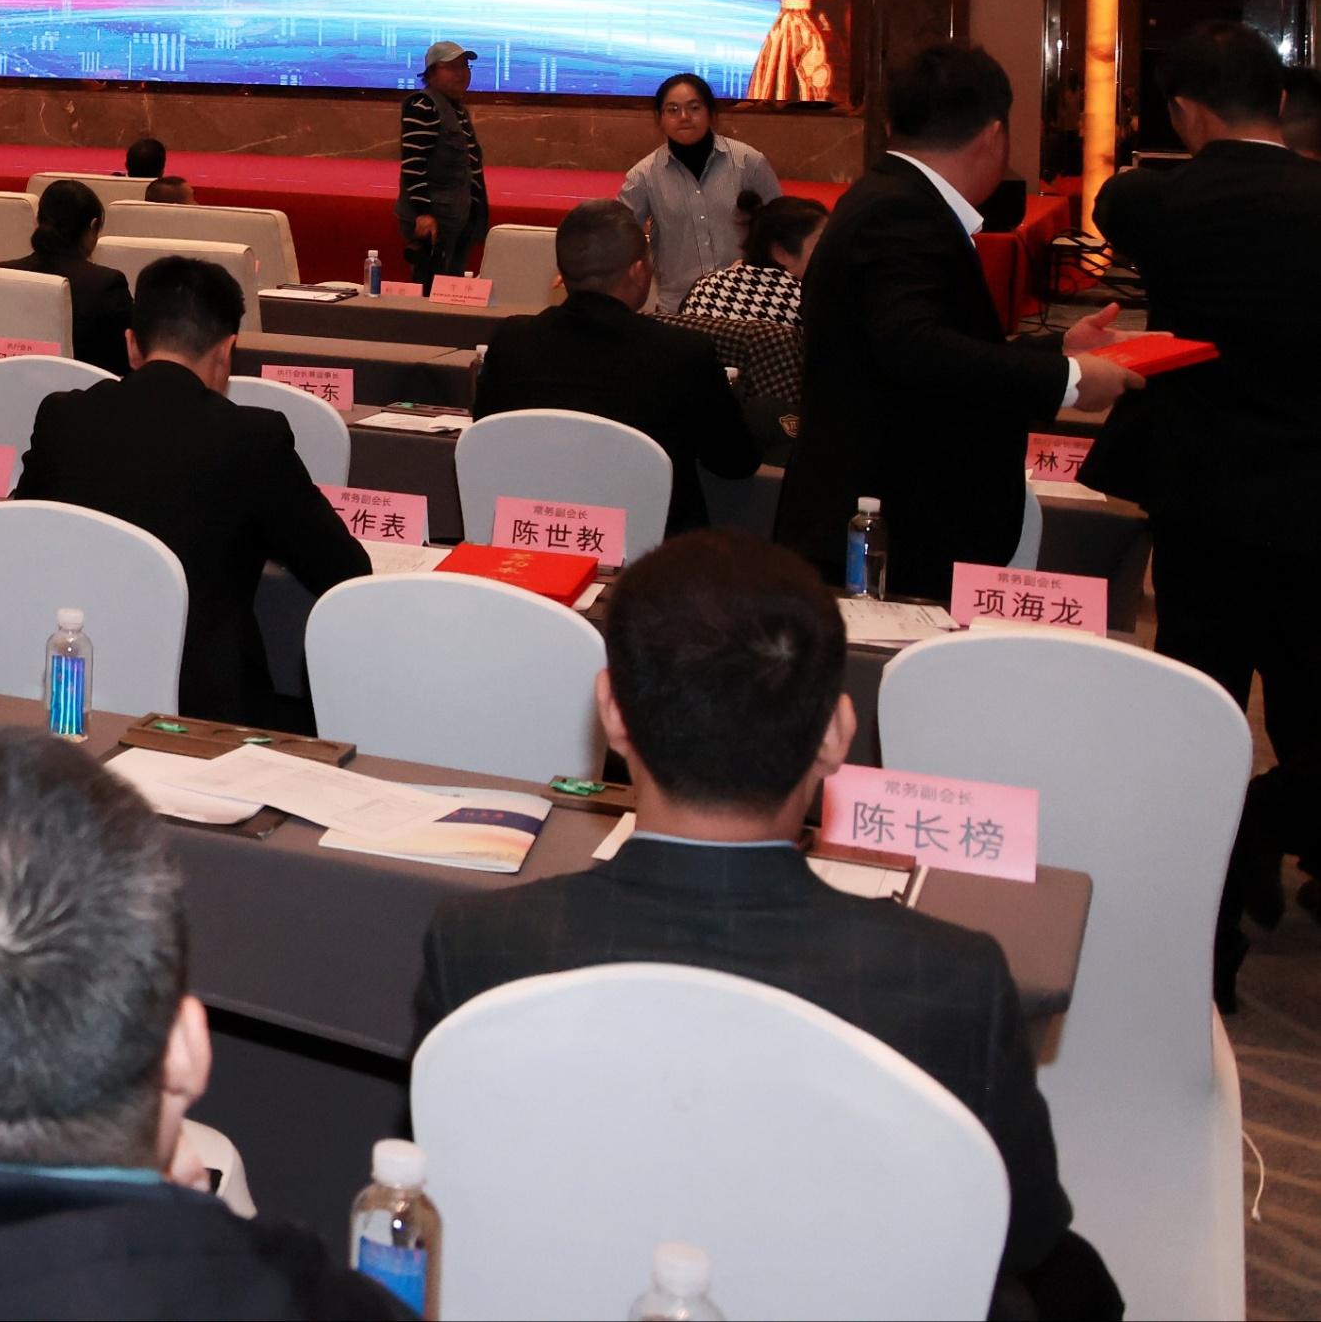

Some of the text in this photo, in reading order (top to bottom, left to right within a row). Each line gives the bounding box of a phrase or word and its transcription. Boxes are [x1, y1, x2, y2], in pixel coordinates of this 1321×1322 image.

[340, 491, 392, 507] 常务副会长
[533, 505, 589, 520] 常务副会长
[333, 507, 406, 539] 作表
[512, 519, 606, 553] 陈世教
[997, 573, 1063, 590] 常务副会长
[973, 589, 1083, 626] 项海龙
[884, 779, 975, 806] 常务副会长
[852, 801, 1005, 860] 陈长榜
